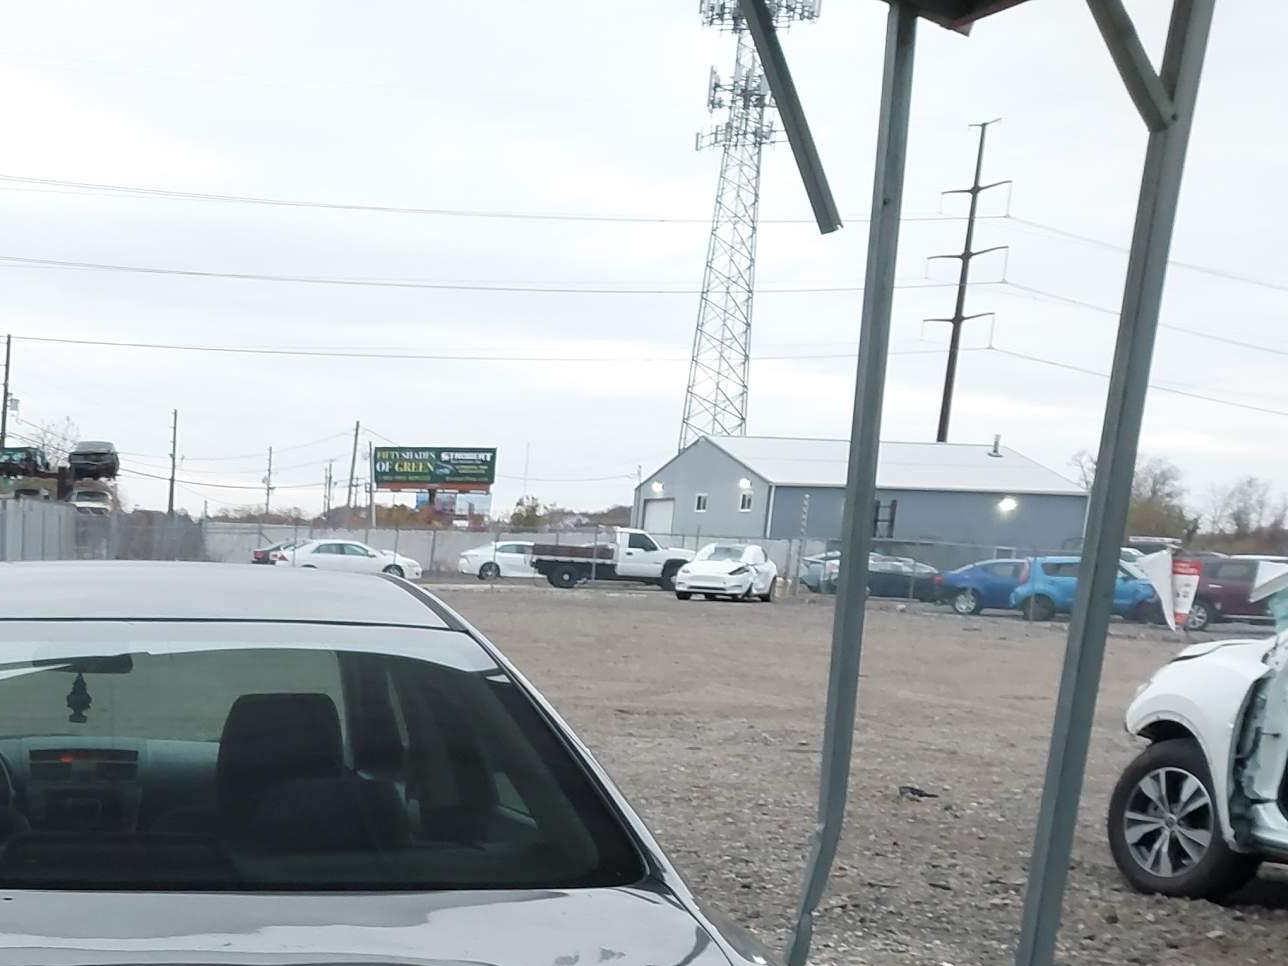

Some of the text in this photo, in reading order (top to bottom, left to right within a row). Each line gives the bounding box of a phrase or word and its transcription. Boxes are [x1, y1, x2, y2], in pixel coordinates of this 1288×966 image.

[376, 450, 436, 460] FIFTY SHADES
[376, 460, 434, 473] OF GREEN
